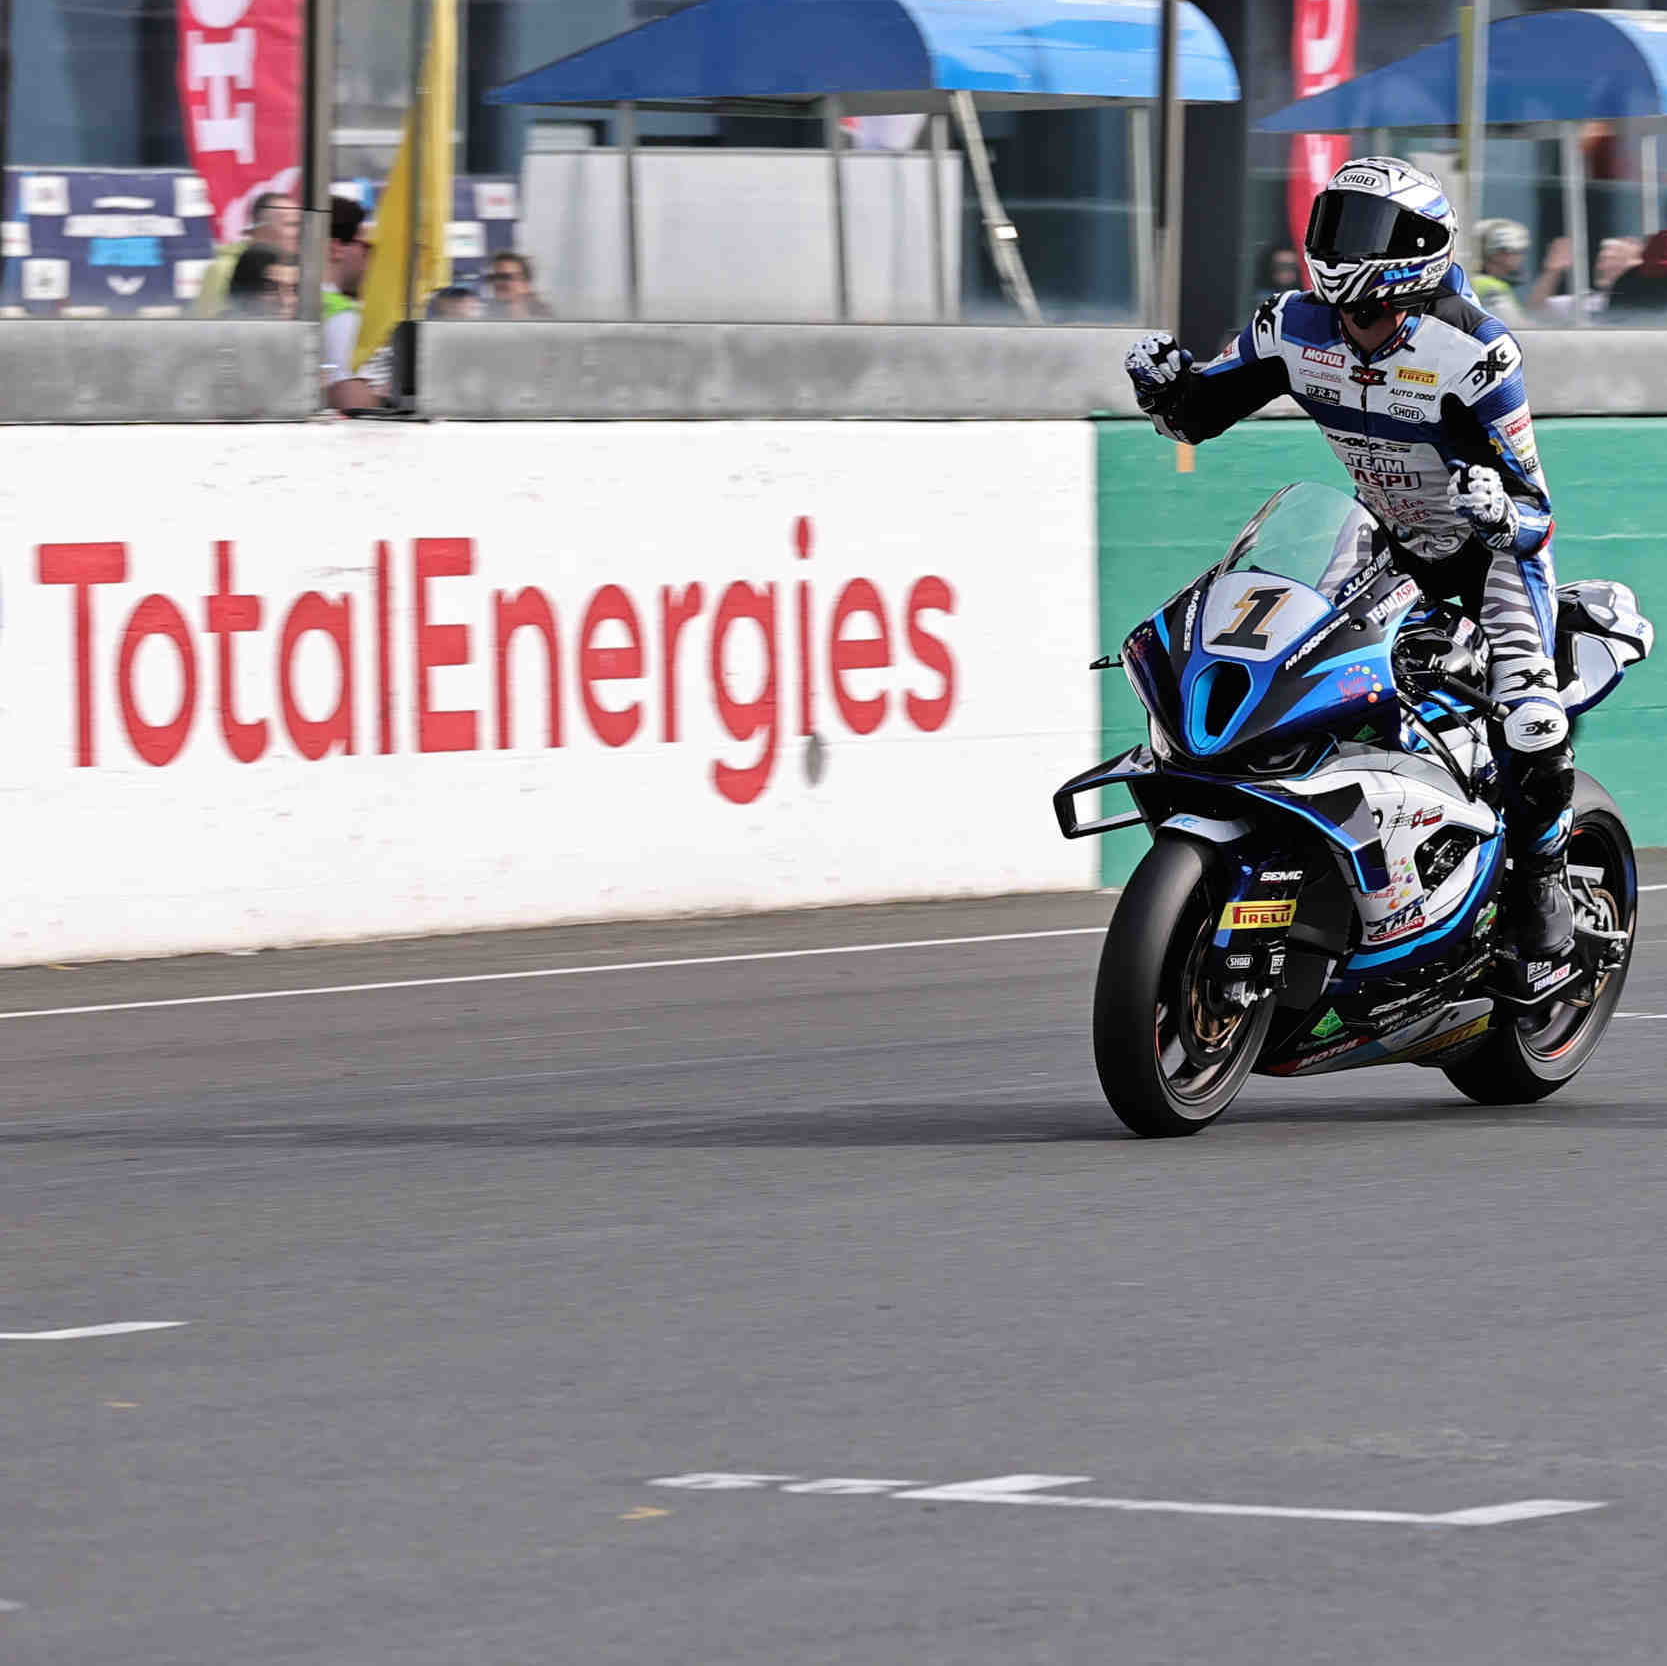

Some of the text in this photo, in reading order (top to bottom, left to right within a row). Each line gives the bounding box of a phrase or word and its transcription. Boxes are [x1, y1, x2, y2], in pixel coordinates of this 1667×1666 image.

[1341, 174, 1377, 187] SHOEI
[1303, 348, 1344, 367] MOTUL
[1392, 406, 1421, 421] SHOEI
[1348, 453, 1404, 474] TEAM
[1353, 469, 1414, 488] ASPI
[1342, 560, 1377, 597] JULIEN
[1209, 585, 1293, 651] 1
[1366, 592, 1398, 626] TEAM
[36, 514, 961, 804] TotalEnergies
[1259, 870, 1303, 883] SEMC
[1232, 904, 1292, 924] PIRELLI
